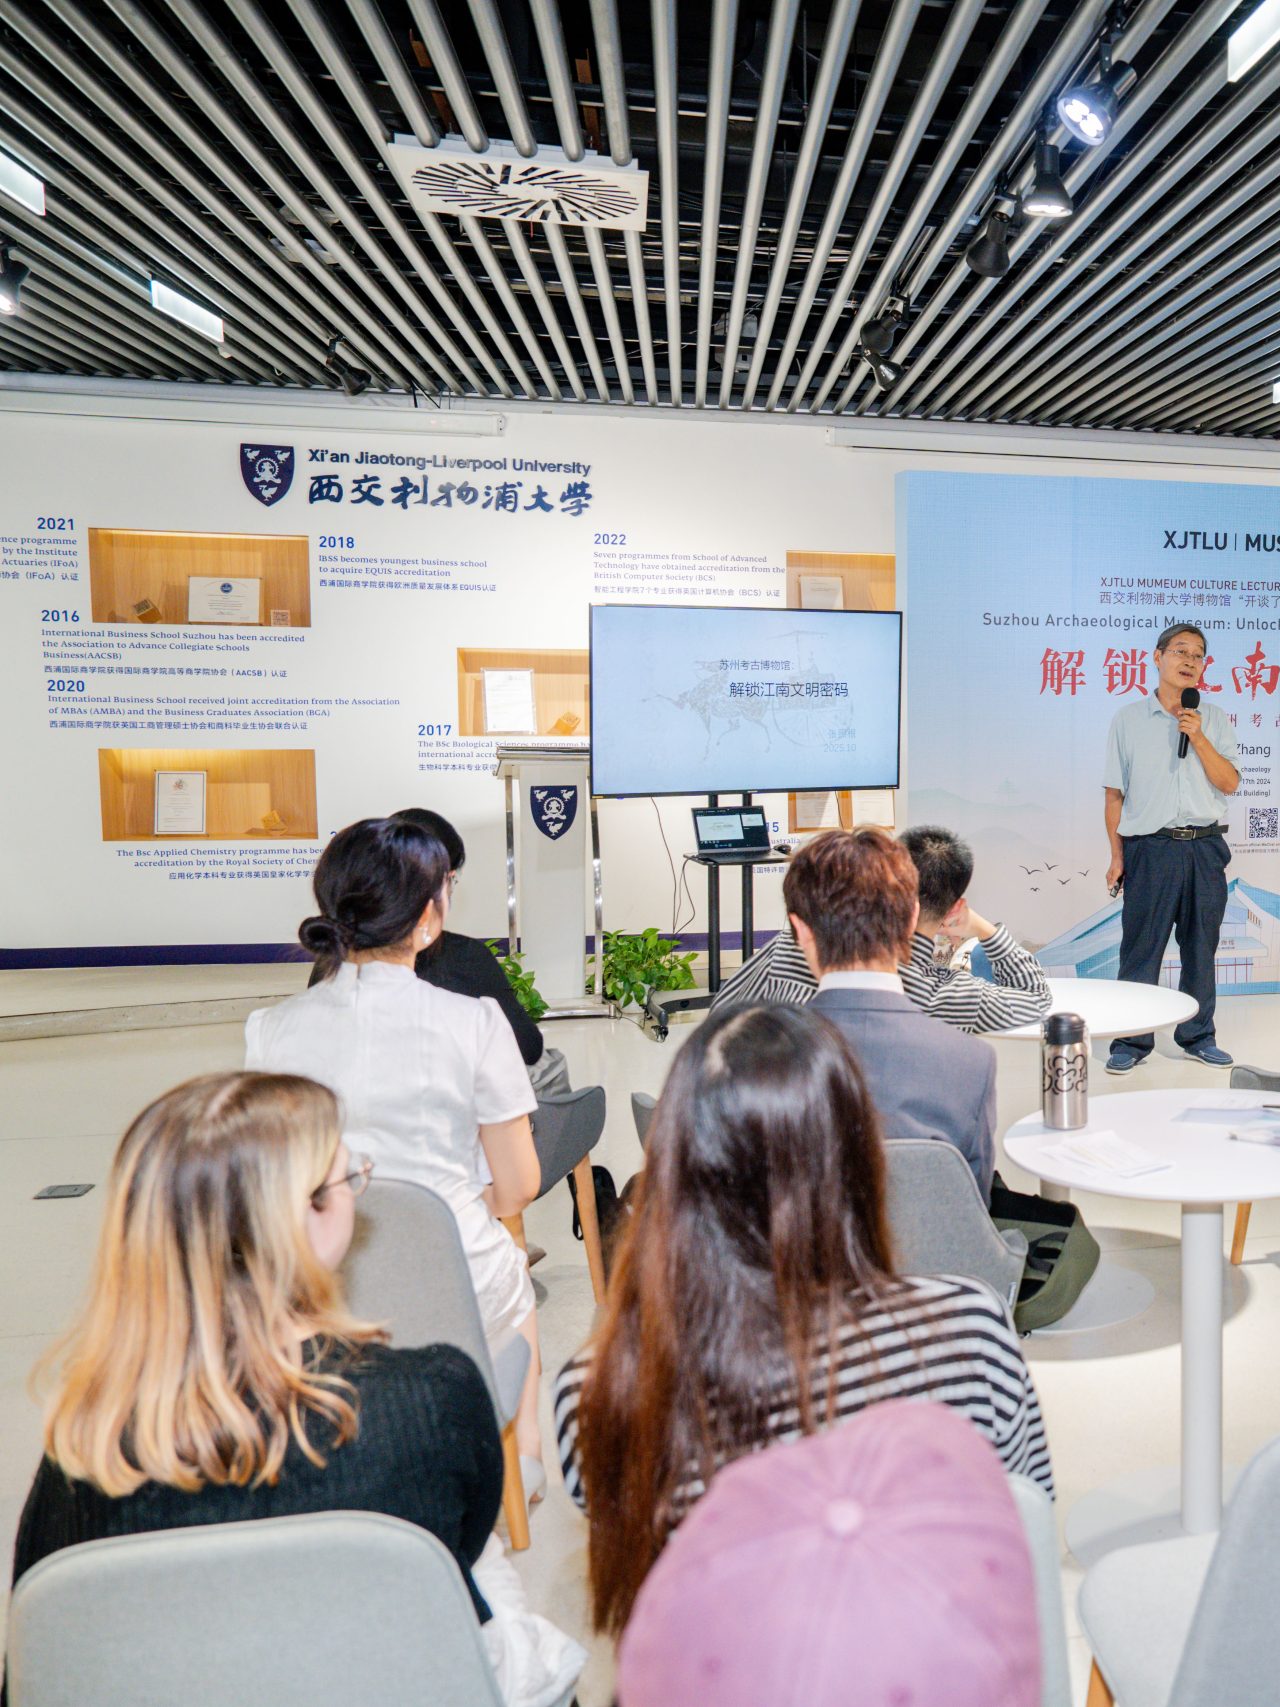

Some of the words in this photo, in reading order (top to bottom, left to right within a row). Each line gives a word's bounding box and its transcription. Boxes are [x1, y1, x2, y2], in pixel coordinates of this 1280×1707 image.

[308, 448, 350, 464] Xi'an
[354, 450, 507, 475] Jiaotong-Liverpool
[512, 458, 592, 478] University
[37, 517, 75, 530] 2021
[21, 537, 78, 547] programme
[319, 536, 355, 549] 2018
[594, 533, 627, 545] 2022
[1163, 530, 1228, 550] XJTLU
[2, 546, 14, 556] by
[16, 547, 33, 555] the
[35, 548, 78, 556] Institute
[1, 558, 48, 567] Actuaries
[49, 560, 79, 568] (IFoA)
[318, 554, 339, 562] IBSS
[340, 555, 379, 564] becomes
[379, 558, 420, 567] youngest
[421, 558, 460, 567] business
[460, 559, 488, 568] school
[618, 553, 670, 561] programmes
[671, 553, 691, 561] from
[692, 553, 719, 561] School
[720, 554, 730, 562] of
[729, 554, 768, 563] Advanced
[330, 566, 364, 575] acquire
[365, 567, 393, 577] EQUIS
[394, 568, 451, 577] accreditation
[594, 561, 638, 571] Technology
[642, 562, 659, 570] have
[661, 563, 696, 571] obtained
[698, 564, 750, 573] accreditation
[751, 565, 771, 573] from
[772, 566, 786, 574] the
[594, 571, 622, 579] British
[623, 572, 664, 582] Computer
[665, 574, 694, 582] Society
[1100, 577, 1134, 588] XJTLU
[1137, 577, 1187, 589] MUMEUM
[1189, 579, 1238, 591] CULTURE
[41, 609, 80, 623] 2016
[983, 612, 1039, 627] Suzhou
[1045, 612, 1158, 632] Archaeological
[42, 628, 105, 637] International
[108, 630, 148, 638] Business
[150, 631, 180, 639] School
[183, 632, 216, 640] Suzhou
[236, 633, 257, 641] been
[260, 634, 305, 642] accredited
[42, 640, 59, 648] the
[60, 640, 115, 648] Association
[128, 642, 167, 650] Advance
[169, 642, 214, 652] Collegiate
[215, 643, 250, 652] Schools
[43, 651, 122, 660] Business(AACSB)
[47, 679, 85, 693] 2020
[729, 681, 849, 698] 解锁江南文明密码
[48, 695, 112, 703] International
[113, 696, 154, 704] Business
[156, 696, 186, 704] School
[188, 696, 225, 704] received
[227, 697, 249, 706] joint
[251, 697, 309, 705] accreditation
[311, 697, 333, 705] from
[351, 698, 400, 706] Association
[89, 708, 126, 716] (AMBA)
[164, 708, 205, 716] Business
[206, 708, 252, 716] Graduates
[418, 724, 452, 736] 2017
[418, 740, 434, 748] The
[436, 740, 450, 748] BSc
[453, 740, 493, 749] Biological
[418, 750, 474, 758] international
[117, 849, 134, 857] The
[154, 848, 188, 858] Applied
[190, 848, 237, 857] Chemistry
[239, 849, 290, 857] programme
[134, 859, 194, 867] accreditation
[196, 859, 207, 868] by
[208, 858, 224, 866] the
[226, 858, 250, 867] Royal
[252, 858, 284, 867] Society
